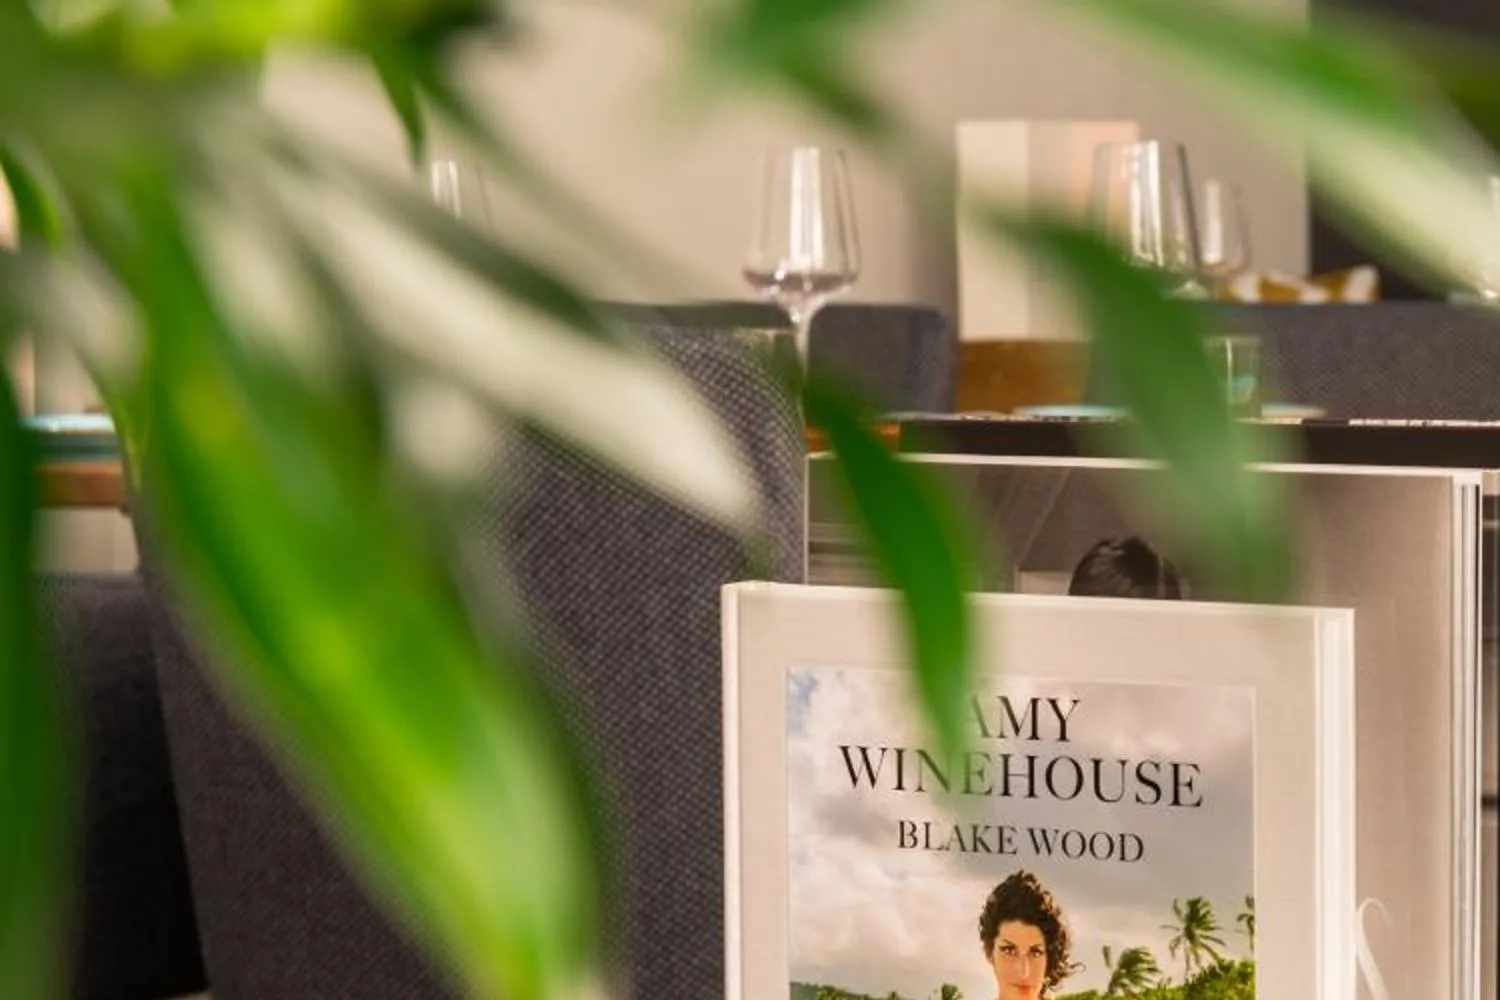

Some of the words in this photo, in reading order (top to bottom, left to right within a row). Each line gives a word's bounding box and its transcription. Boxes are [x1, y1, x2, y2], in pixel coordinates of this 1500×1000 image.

[969, 693, 1081, 743] AMY
[838, 744, 1204, 808] WINEHOUSE
[897, 819, 1018, 856] BLAKE
[1026, 827, 1145, 863] WOOD
